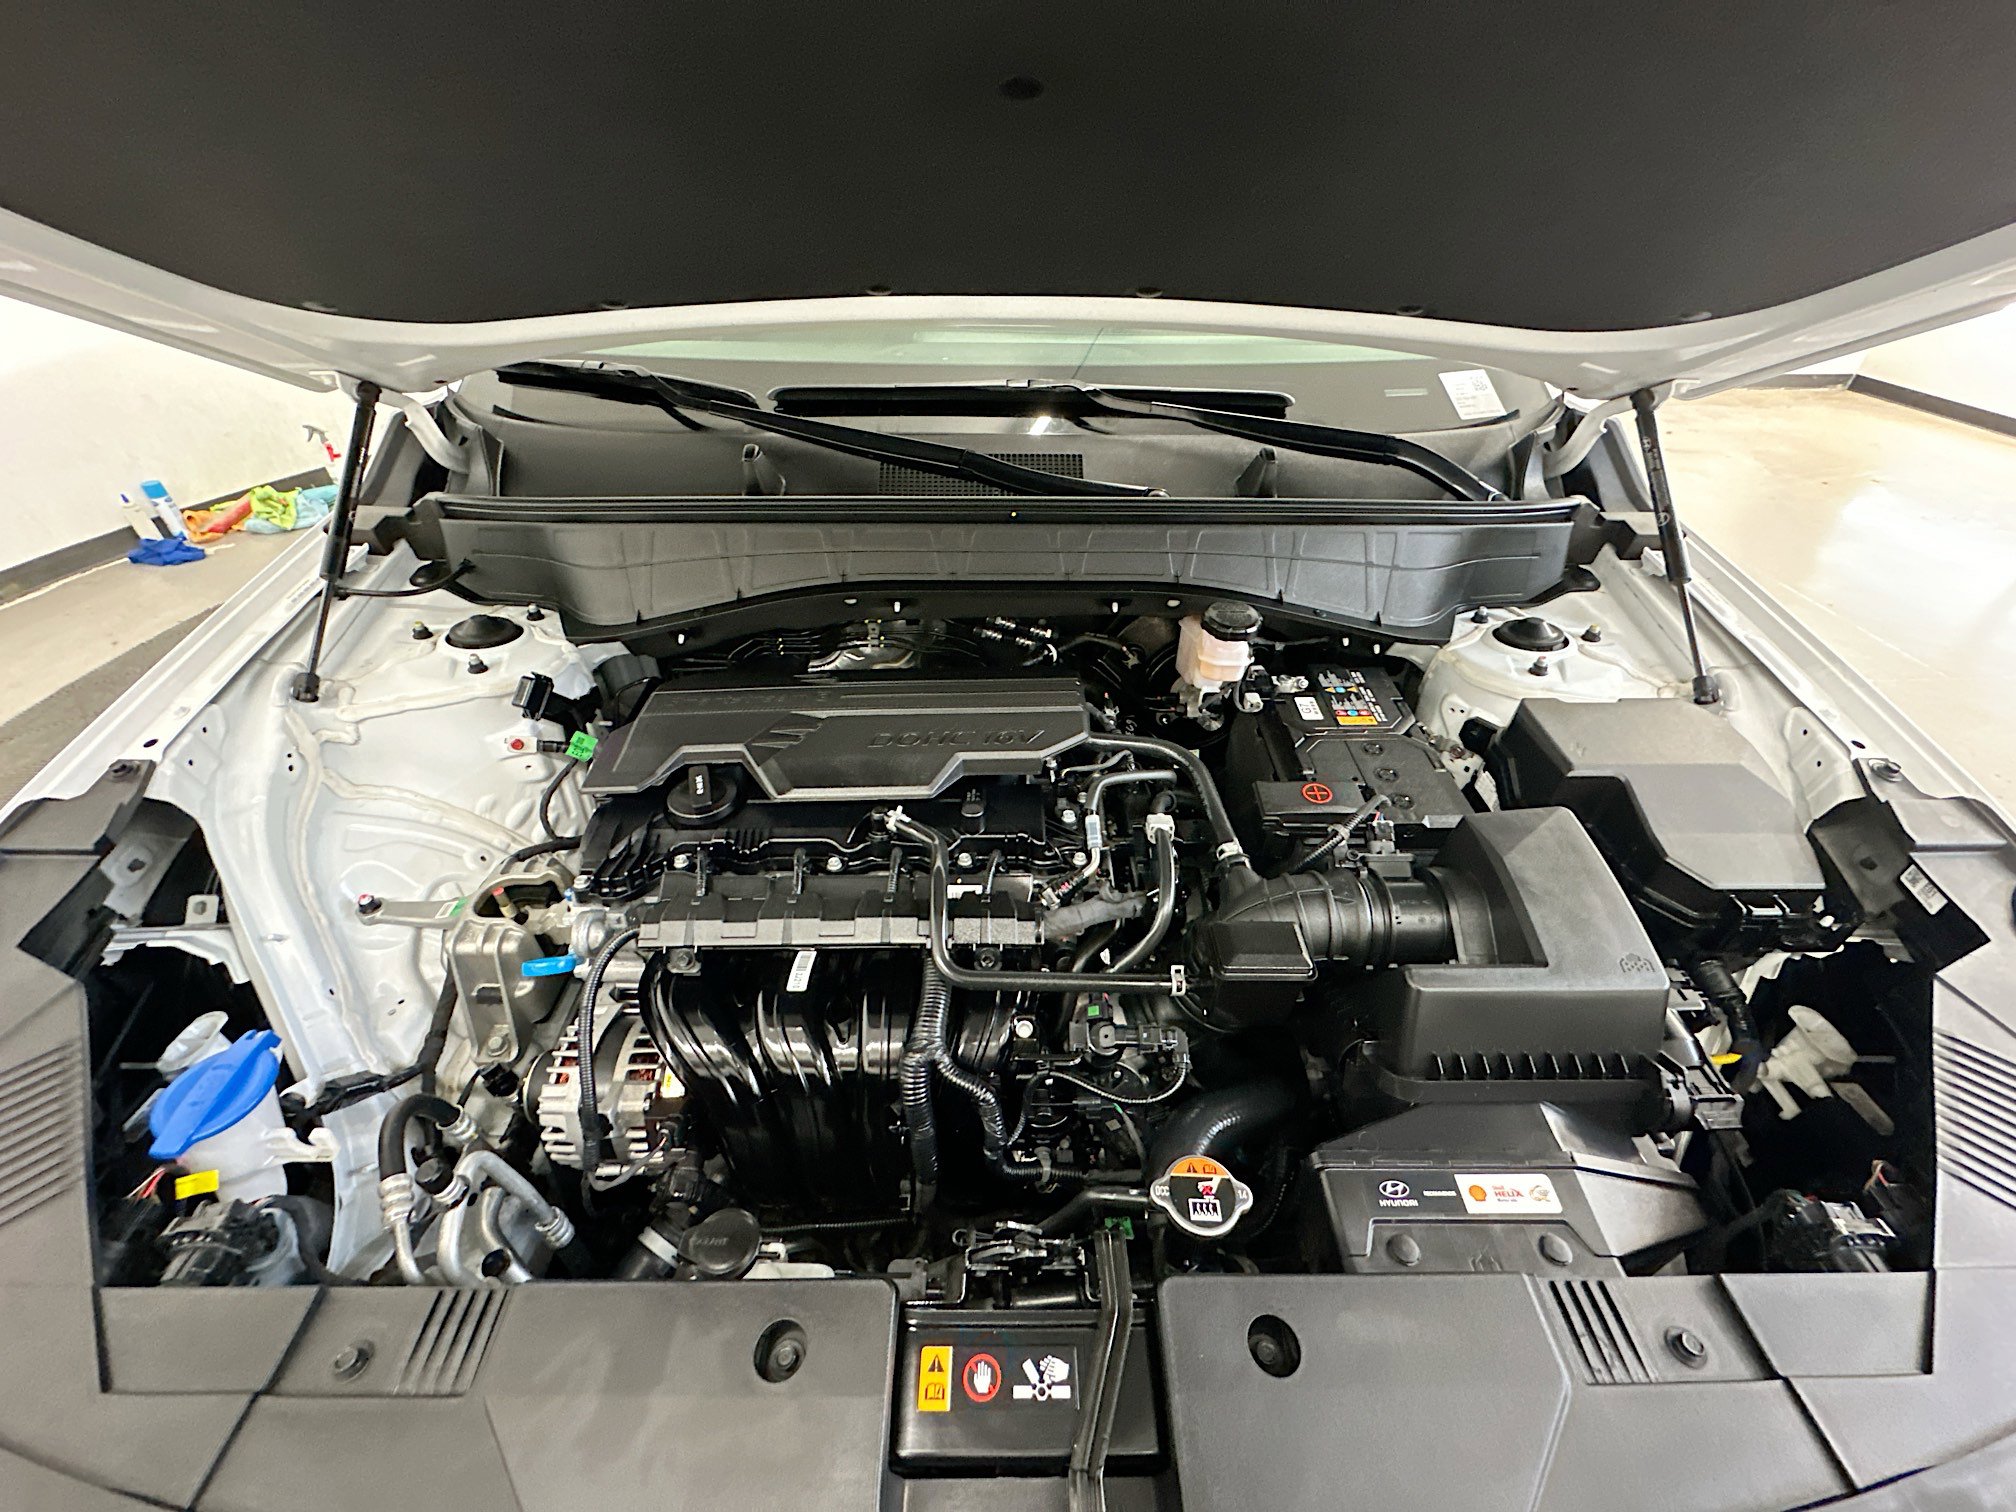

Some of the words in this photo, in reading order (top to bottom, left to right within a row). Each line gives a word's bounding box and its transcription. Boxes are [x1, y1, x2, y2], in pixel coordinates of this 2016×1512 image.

[867, 730, 976, 748] DOHC
[982, 729, 1045, 746] 16V
[1494, 1189, 1524, 1198] HELIX
[1378, 1199, 1419, 1208] HYUNDAI
